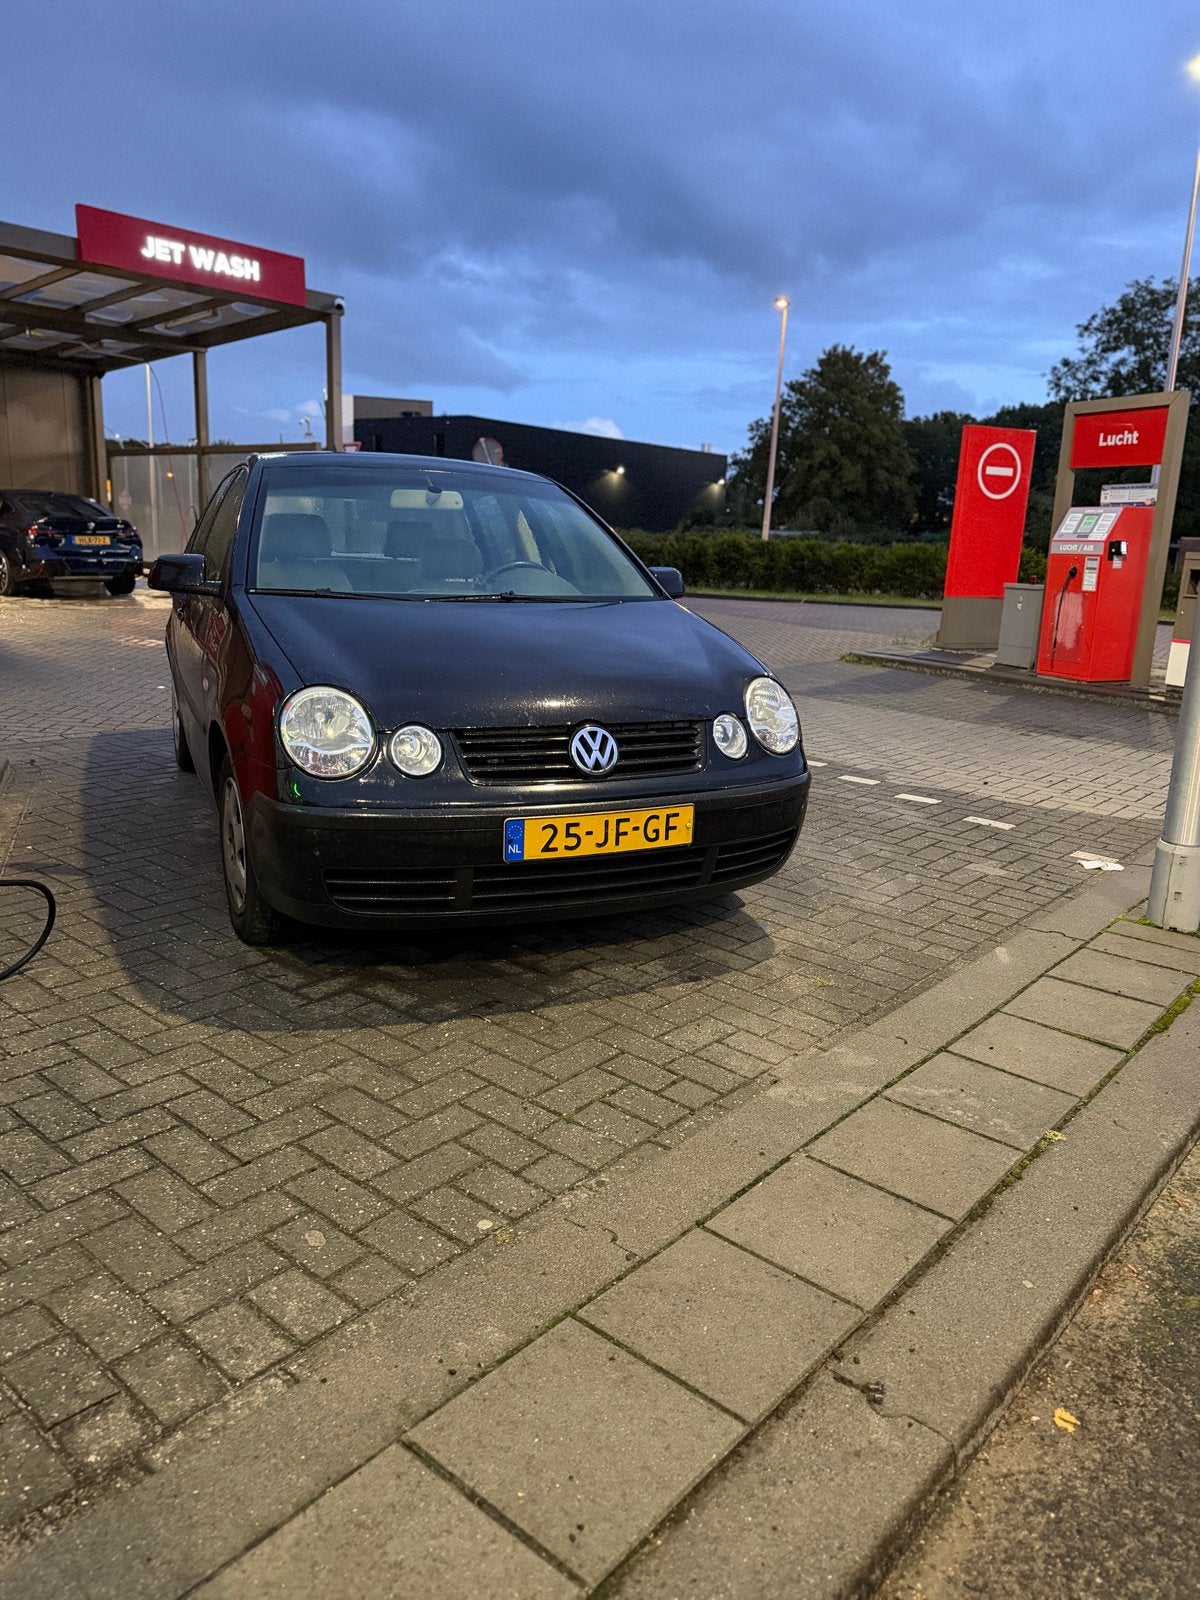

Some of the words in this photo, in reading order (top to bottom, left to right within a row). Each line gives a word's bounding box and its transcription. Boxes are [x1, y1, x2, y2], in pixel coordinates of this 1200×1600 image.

[141, 236, 185, 264] JET
[188, 245, 260, 282] WASH
[1098, 430, 1139, 446] Lucht
[1083, 544, 1094, 552] AIR
[540, 812, 680, 853] 25-JF-GF
[508, 844, 522, 854] NL
